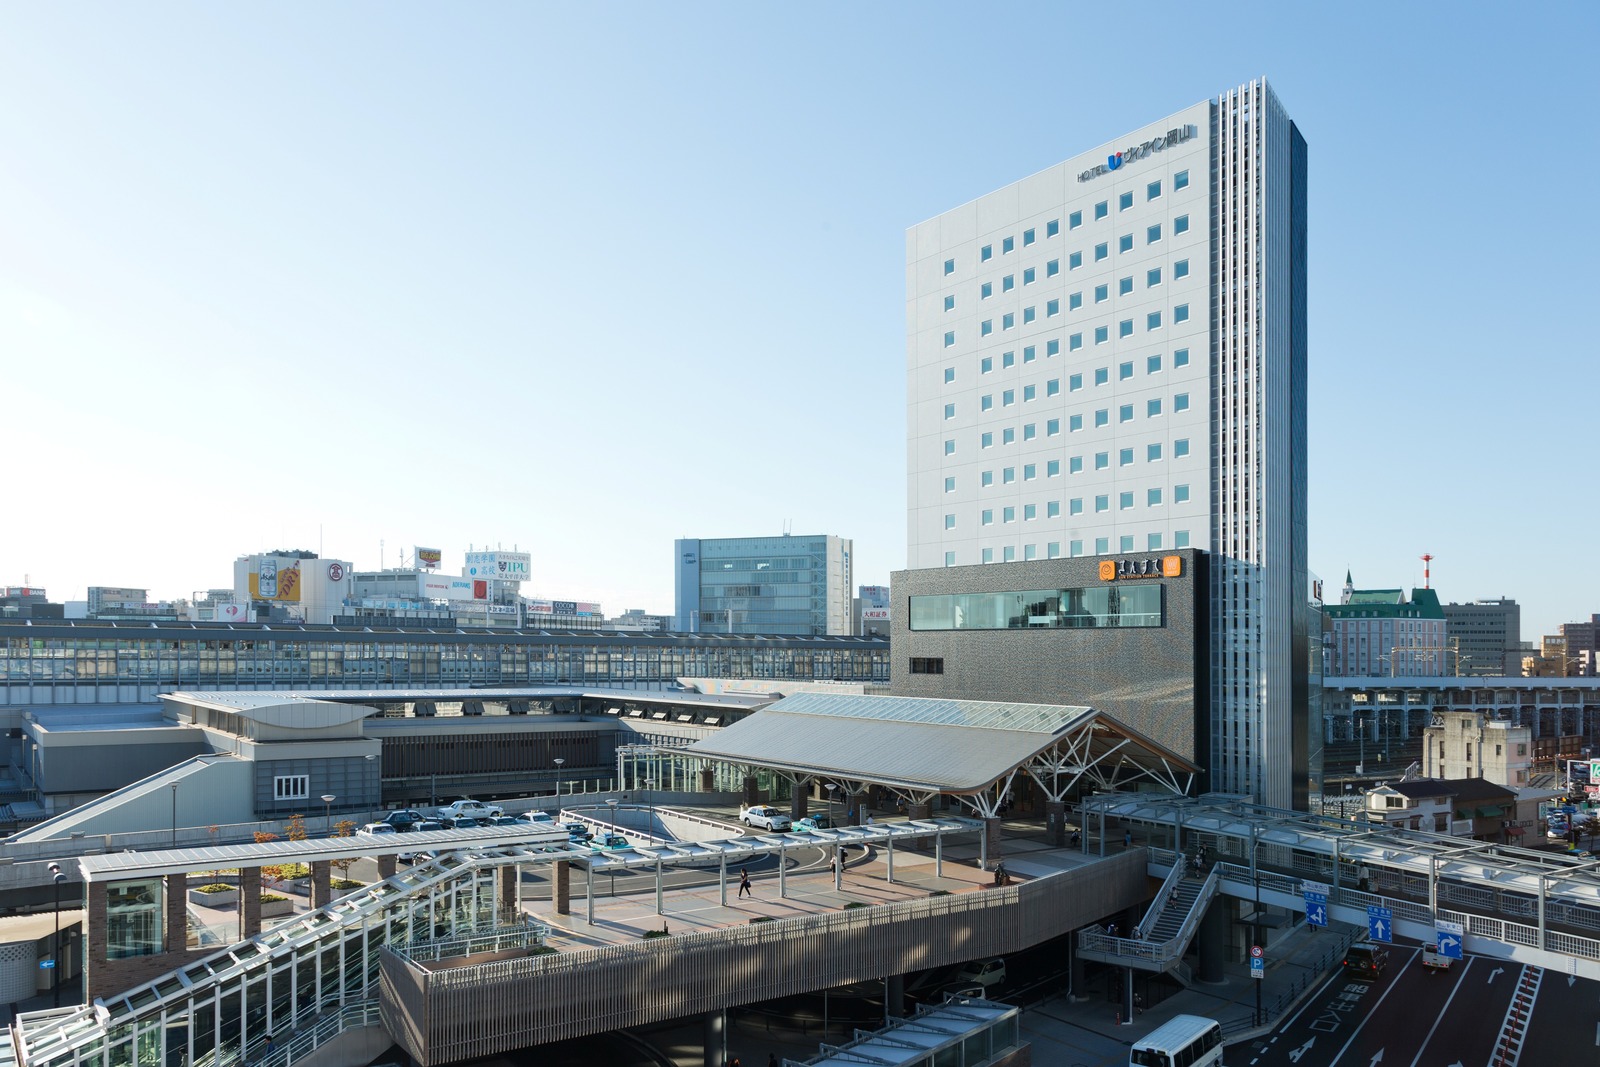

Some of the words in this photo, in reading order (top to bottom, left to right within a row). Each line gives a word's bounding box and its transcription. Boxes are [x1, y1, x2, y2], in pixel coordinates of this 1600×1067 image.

[1123, 124, 1191, 163] ヴィアイン岡山
[1077, 164, 1107, 182] HOTEL
[507, 562, 529, 573] IPU
[1254, 958, 1262, 968] P
